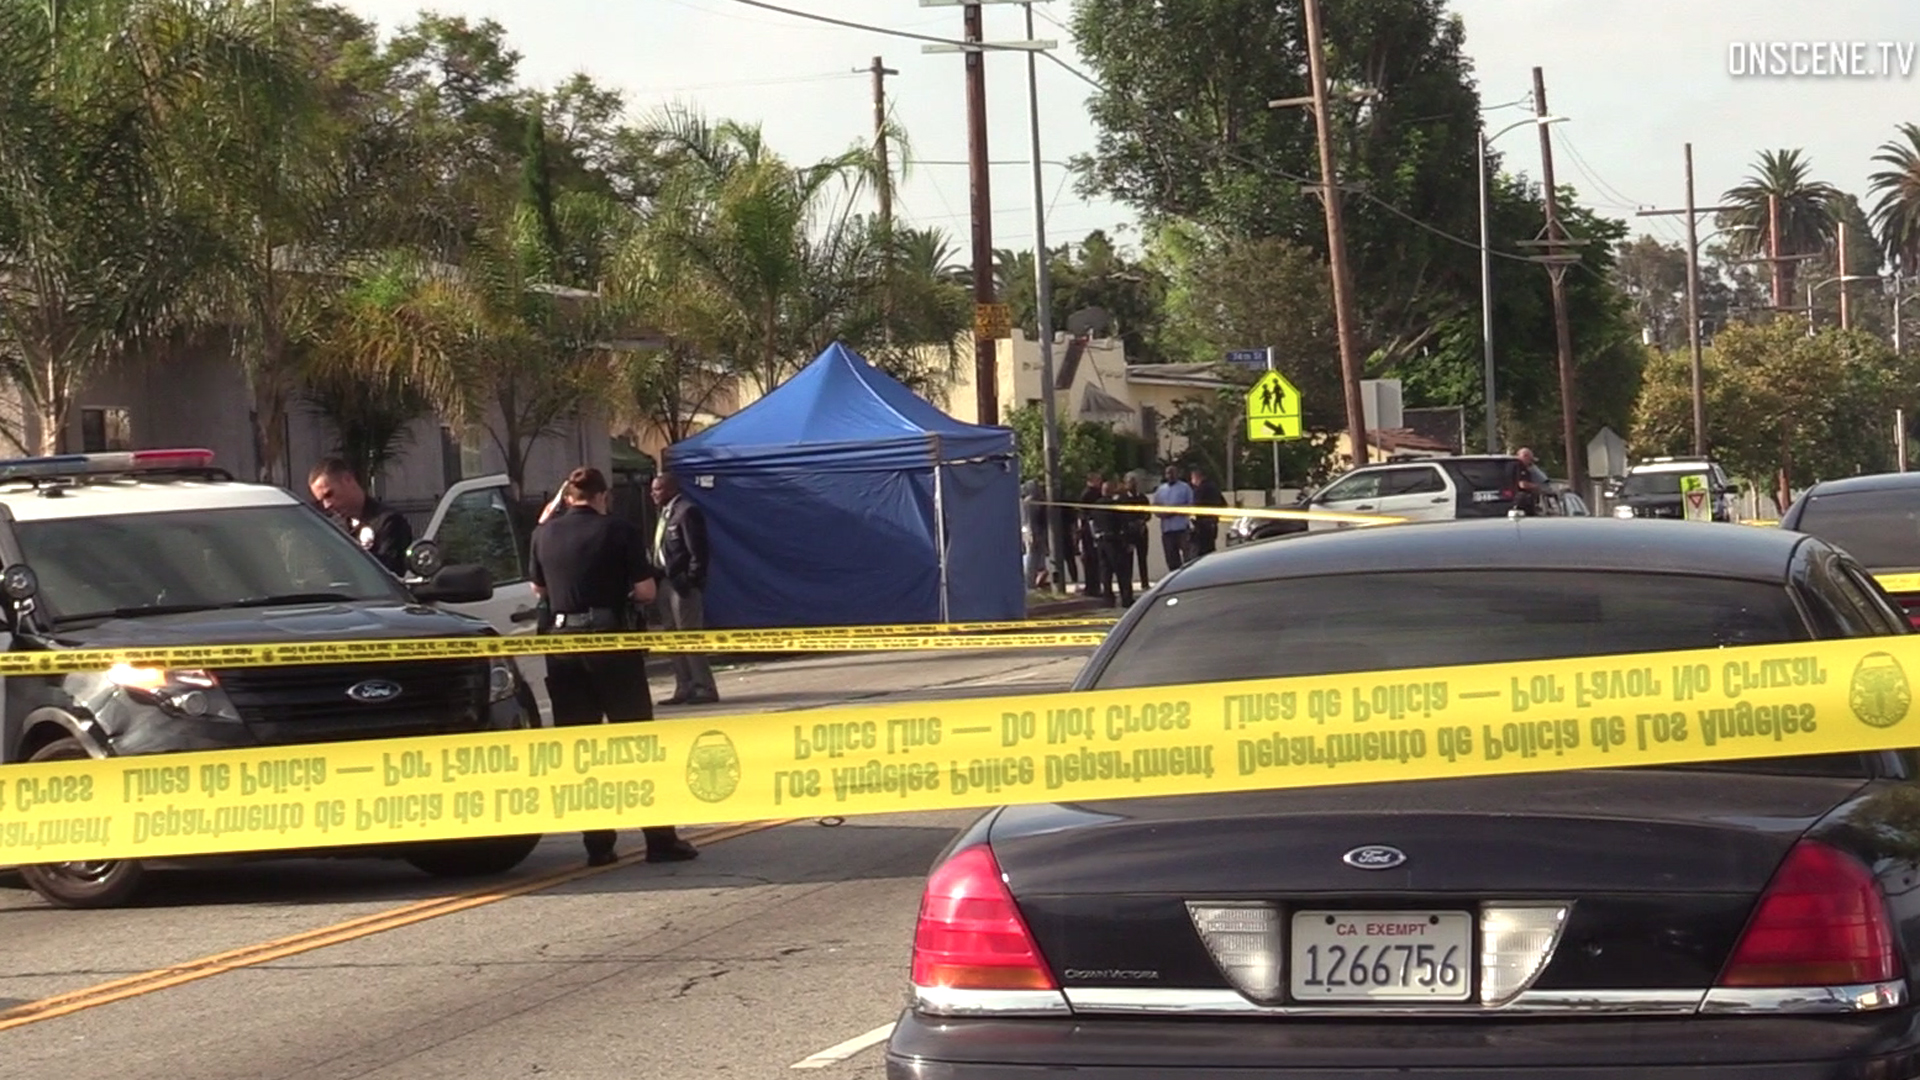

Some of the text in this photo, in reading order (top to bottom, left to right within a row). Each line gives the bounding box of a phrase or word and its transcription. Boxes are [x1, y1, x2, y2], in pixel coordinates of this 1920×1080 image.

[1357, 849, 1392, 864] Ford
[1337, 922, 1427, 936] CA EXEMPT
[1304, 943, 1460, 987] 1266756
